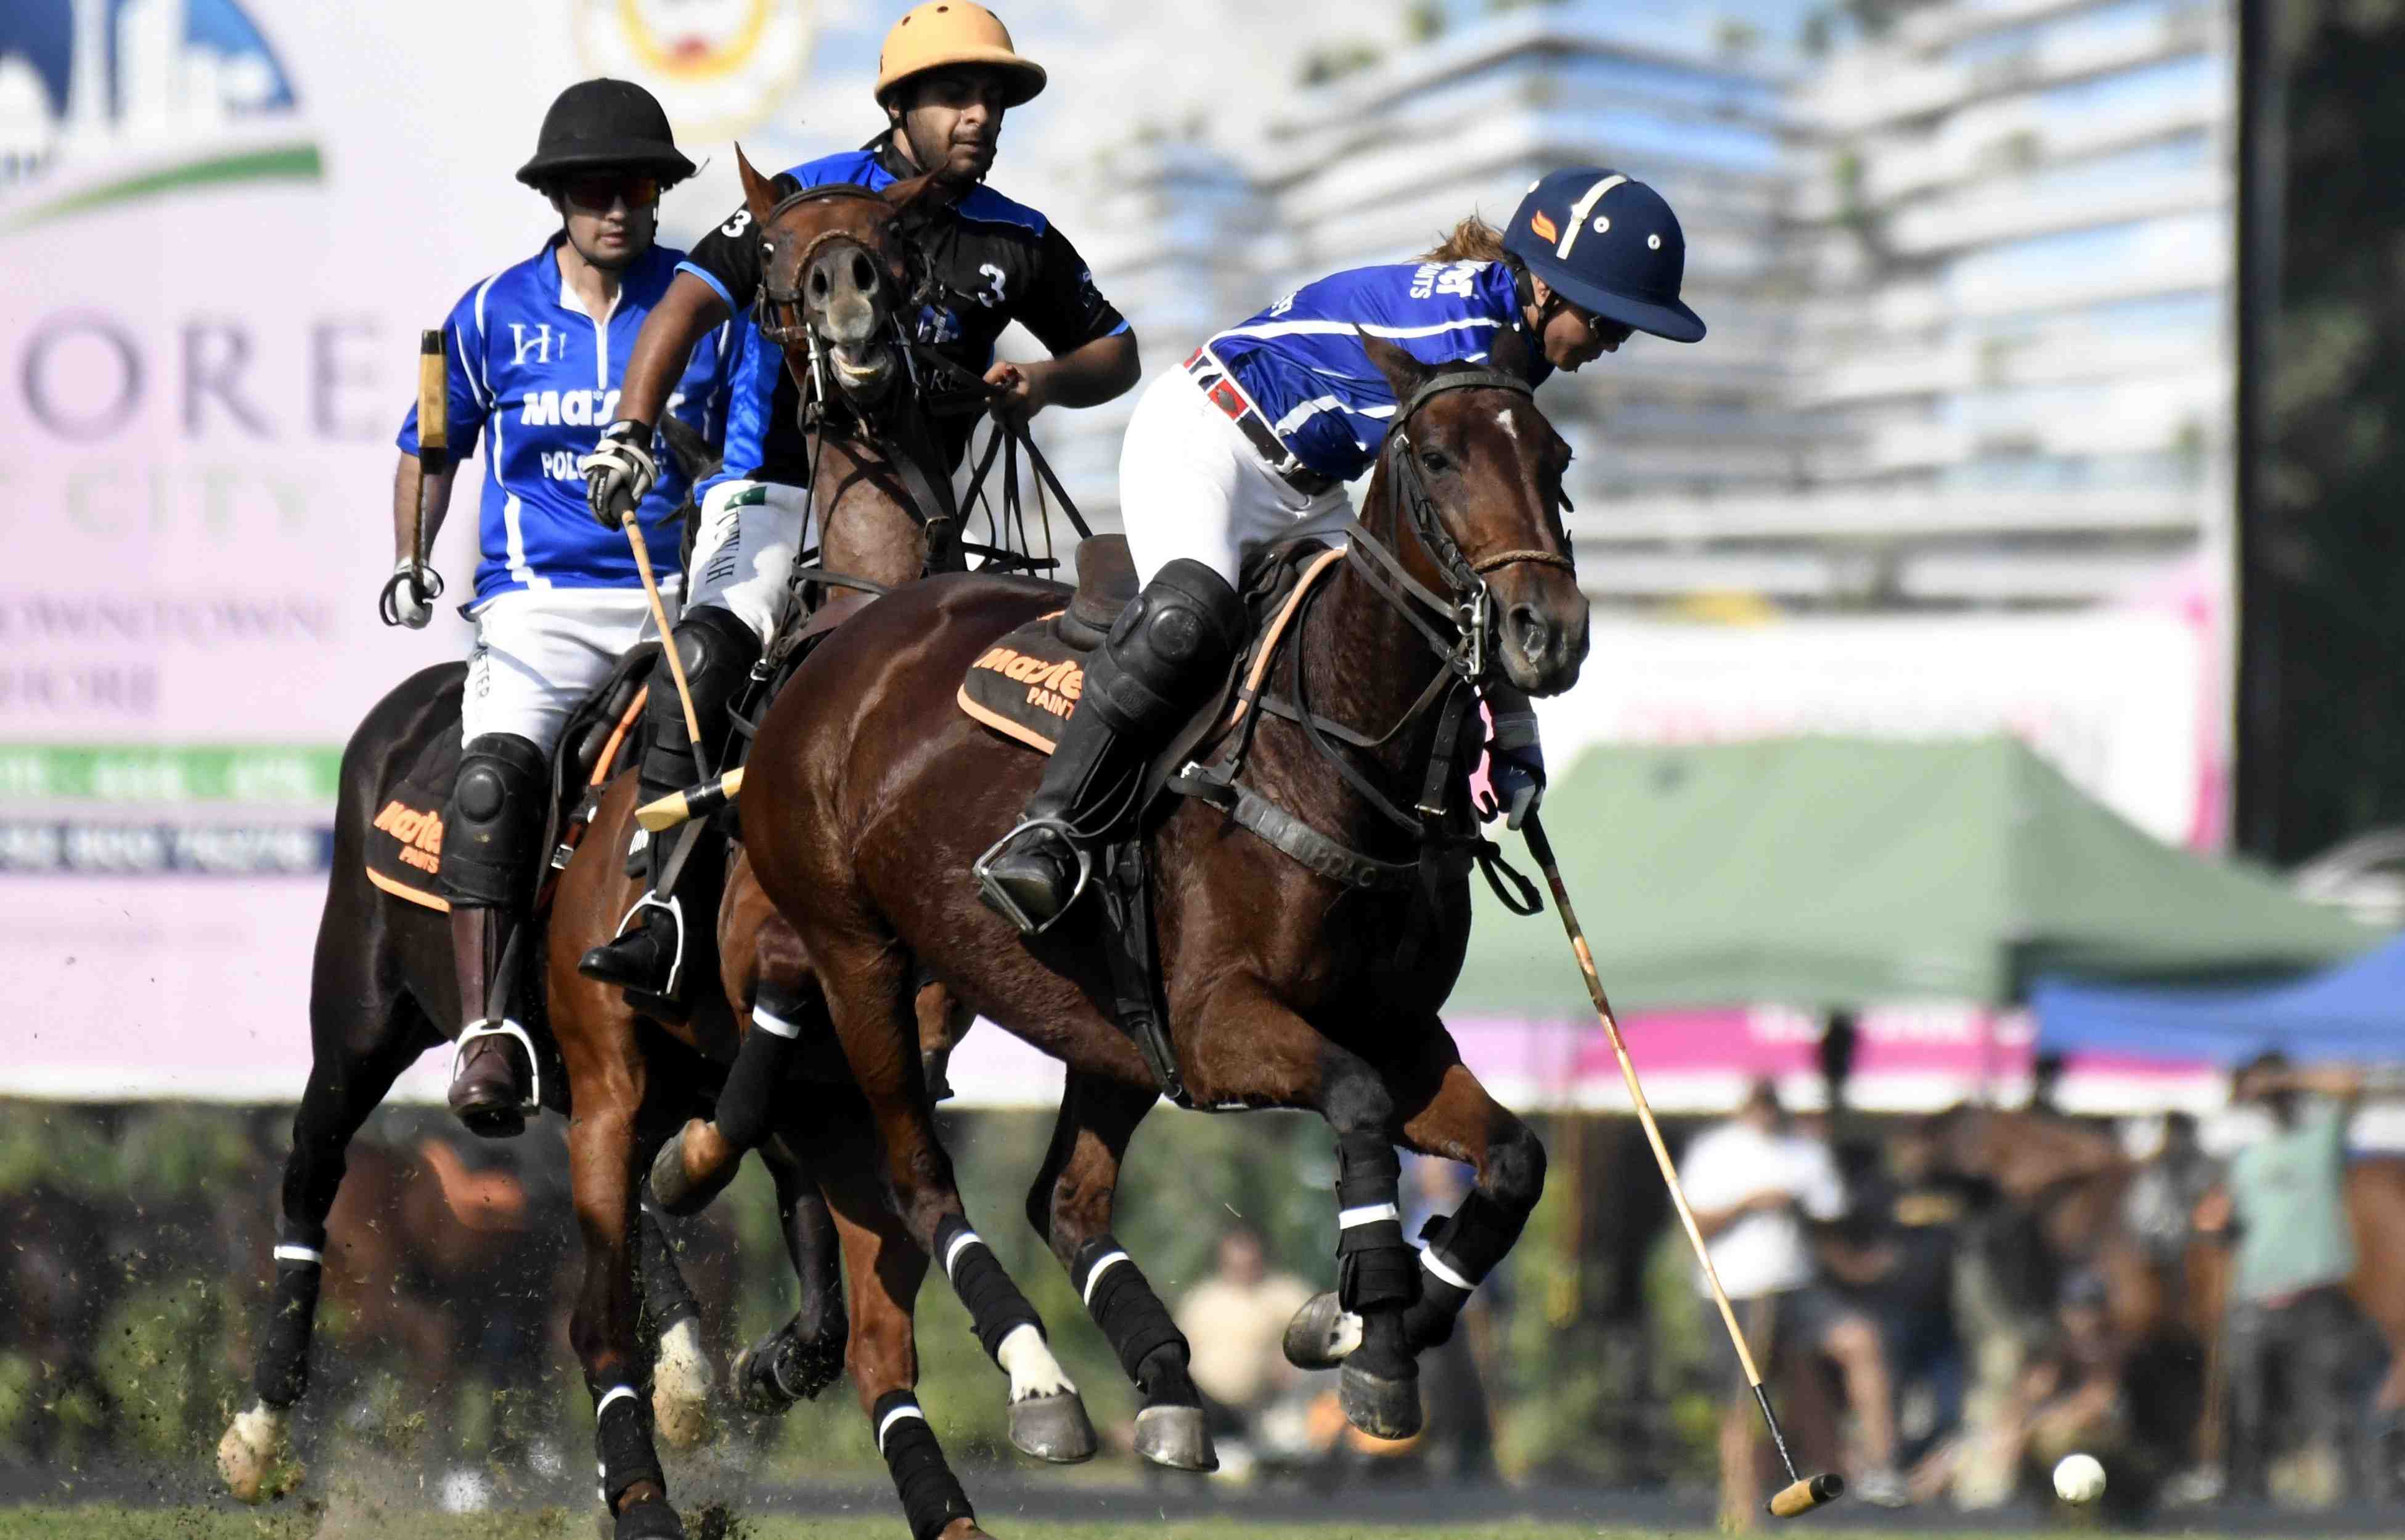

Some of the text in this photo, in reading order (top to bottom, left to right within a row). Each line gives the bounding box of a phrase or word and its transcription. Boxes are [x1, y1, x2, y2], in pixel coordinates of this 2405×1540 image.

[721, 210, 751, 237] 3
[978, 264, 1006, 308] 3
[1026, 686, 1076, 720] PAINT
